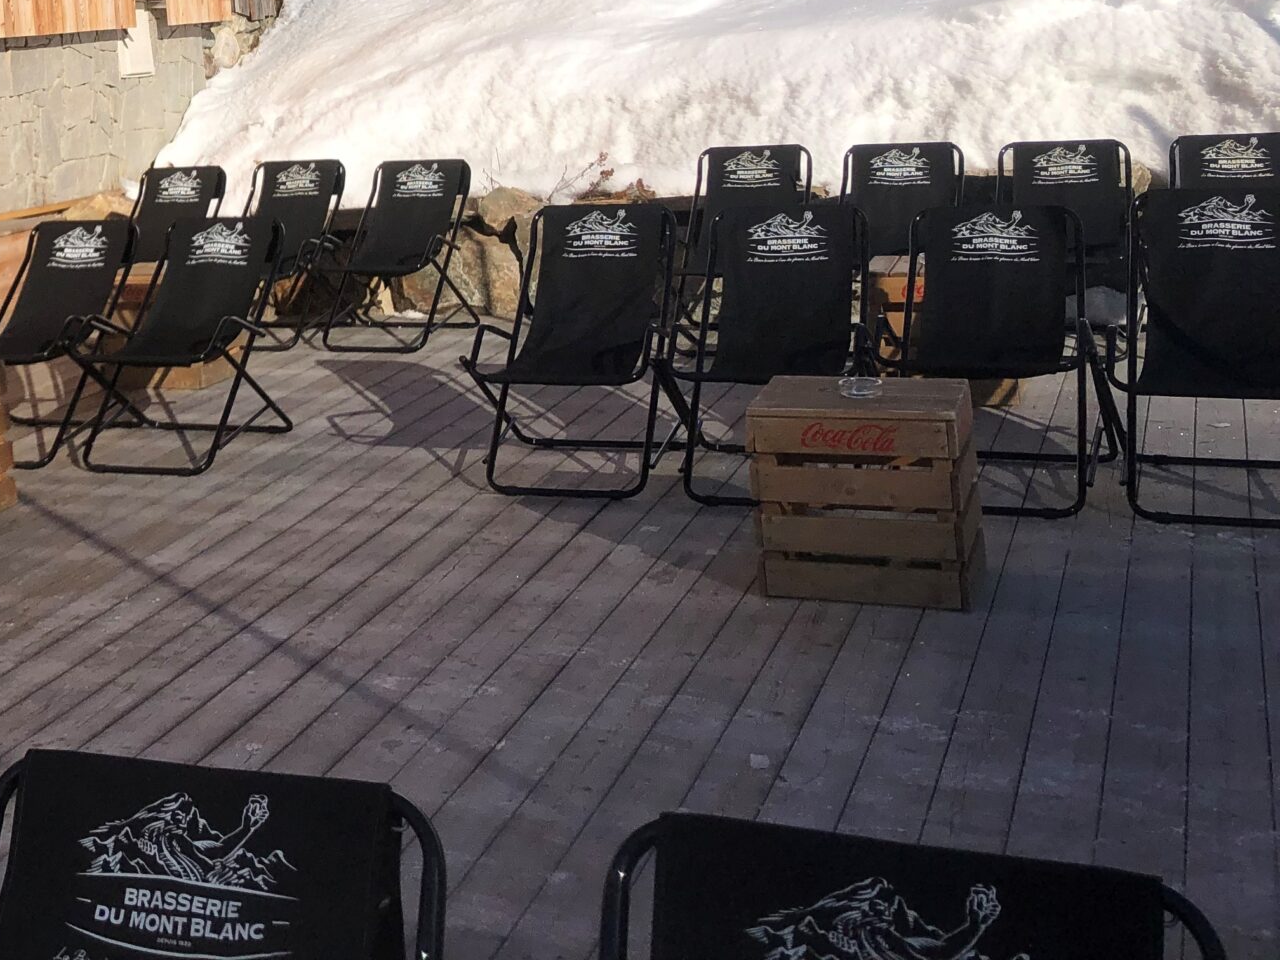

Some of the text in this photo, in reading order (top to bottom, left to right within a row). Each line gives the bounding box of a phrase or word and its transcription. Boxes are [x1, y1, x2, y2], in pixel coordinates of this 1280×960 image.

[1201, 222, 1252, 230] BRASSERIE
[972, 237, 1018, 245] BRASSERIE
[124, 887, 243, 919] BRASSERIE
[94, 904, 266, 941] DU MONT BLANC
